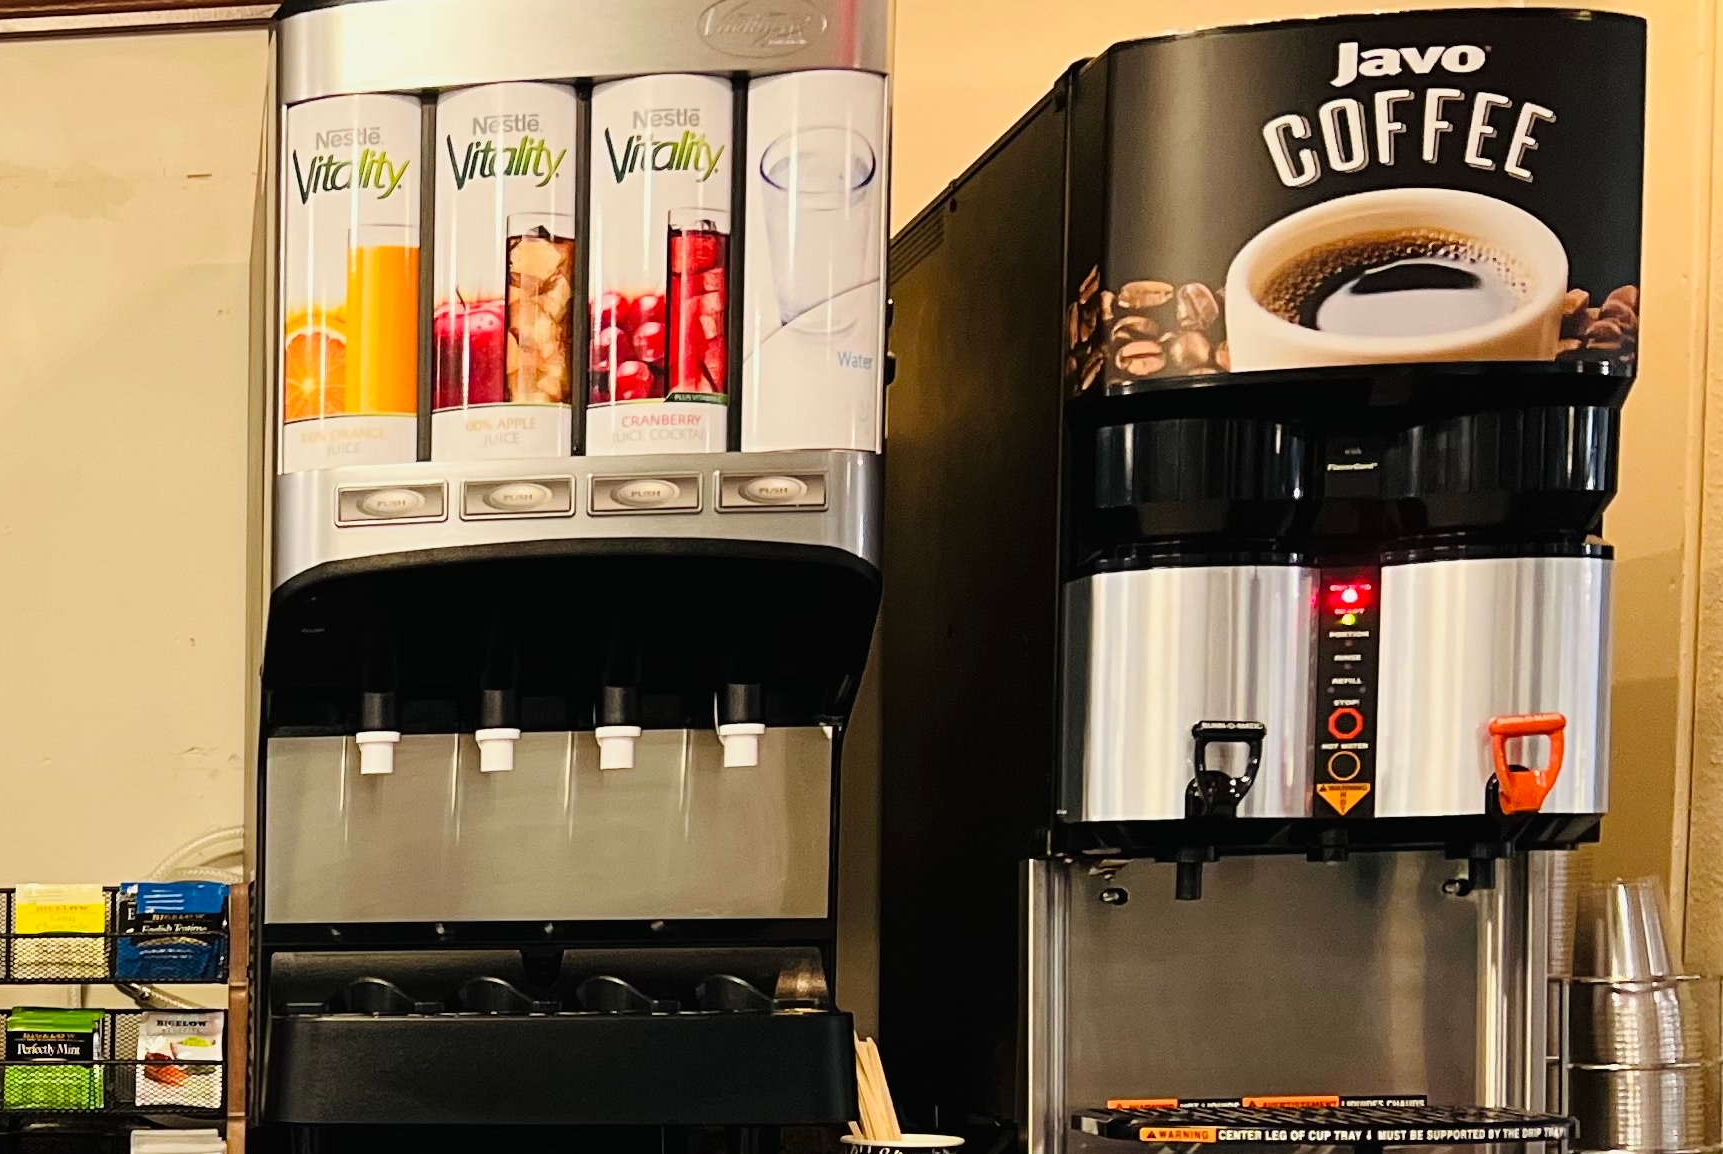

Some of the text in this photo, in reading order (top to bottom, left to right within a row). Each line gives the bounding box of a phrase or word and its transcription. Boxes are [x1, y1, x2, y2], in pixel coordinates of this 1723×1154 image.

[1330, 42, 1486, 87] Javo
[1262, 89, 1556, 187] COFFEE
[446, 135, 567, 190] Vitality
[604, 127, 725, 184] Vitality
[292, 148, 411, 205] Vitality
[838, 351, 873, 370] Water
[497, 417, 536, 430] APPLE
[622, 414, 701, 428] CRANBERRY
[485, 433, 520, 447] JUICE
[503, 494, 533, 502] PUSH
[631, 489, 661, 497] PUSH
[377, 499, 406, 507] PUSH
[157, 1019, 207, 1027] BIGELOW
[17, 1042, 81, 1056] Perfectly Mint
[1159, 1130, 1209, 1140] WARNING
[1218, 1126, 1565, 1141] CENTER LEG OF CUP TRAY MUST BE SUPPORTED BY THE DRIP TRAY
